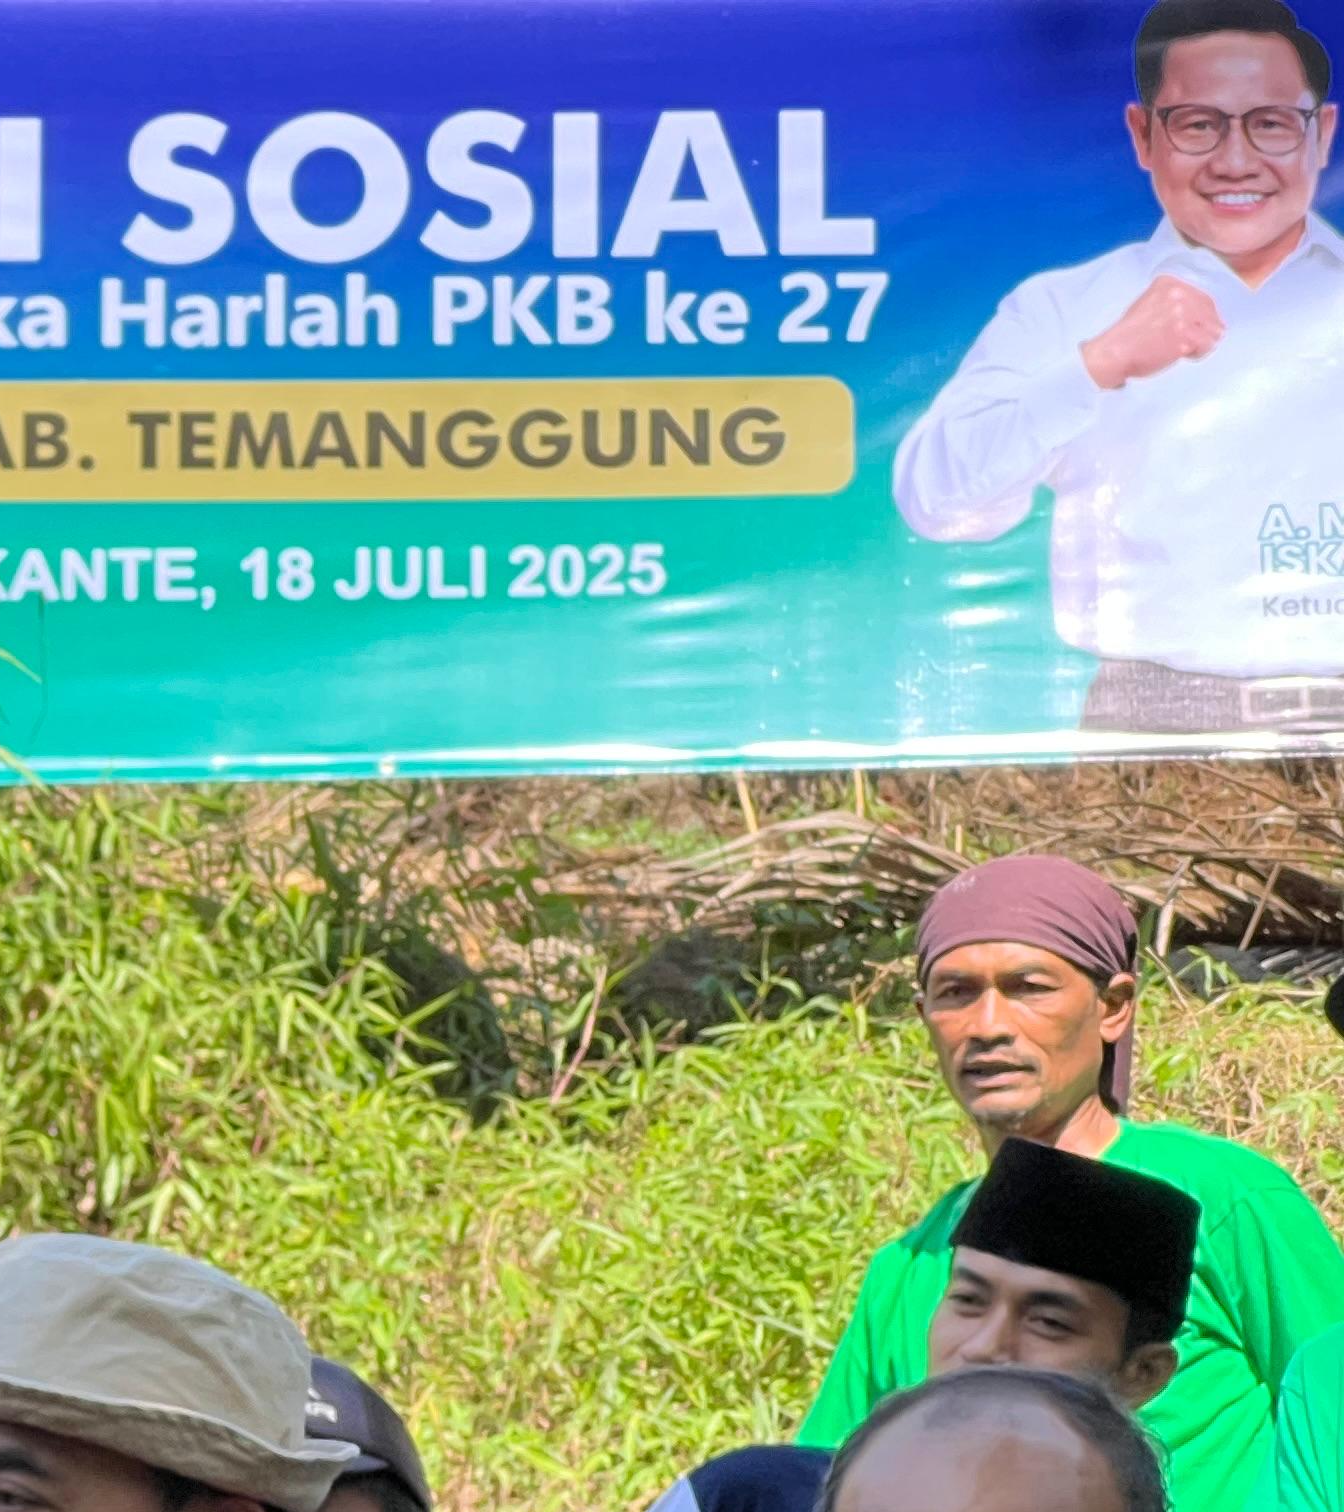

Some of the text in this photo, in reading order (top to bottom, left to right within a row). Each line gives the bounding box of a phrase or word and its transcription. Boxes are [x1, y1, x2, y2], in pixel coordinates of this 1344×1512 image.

[121, 108, 875, 265] SOSIAL
[101, 271, 398, 349] Harlah
[432, 274, 614, 346] PKB
[645, 269, 749, 345] ke
[778, 271, 889, 343] 27
[127, 407, 786, 471] TEMANGGUNG
[1257, 503, 1311, 541] A.
[241, 547, 315, 601] 18
[334, 546, 487, 601] JULI
[508, 543, 667, 597] 2025
